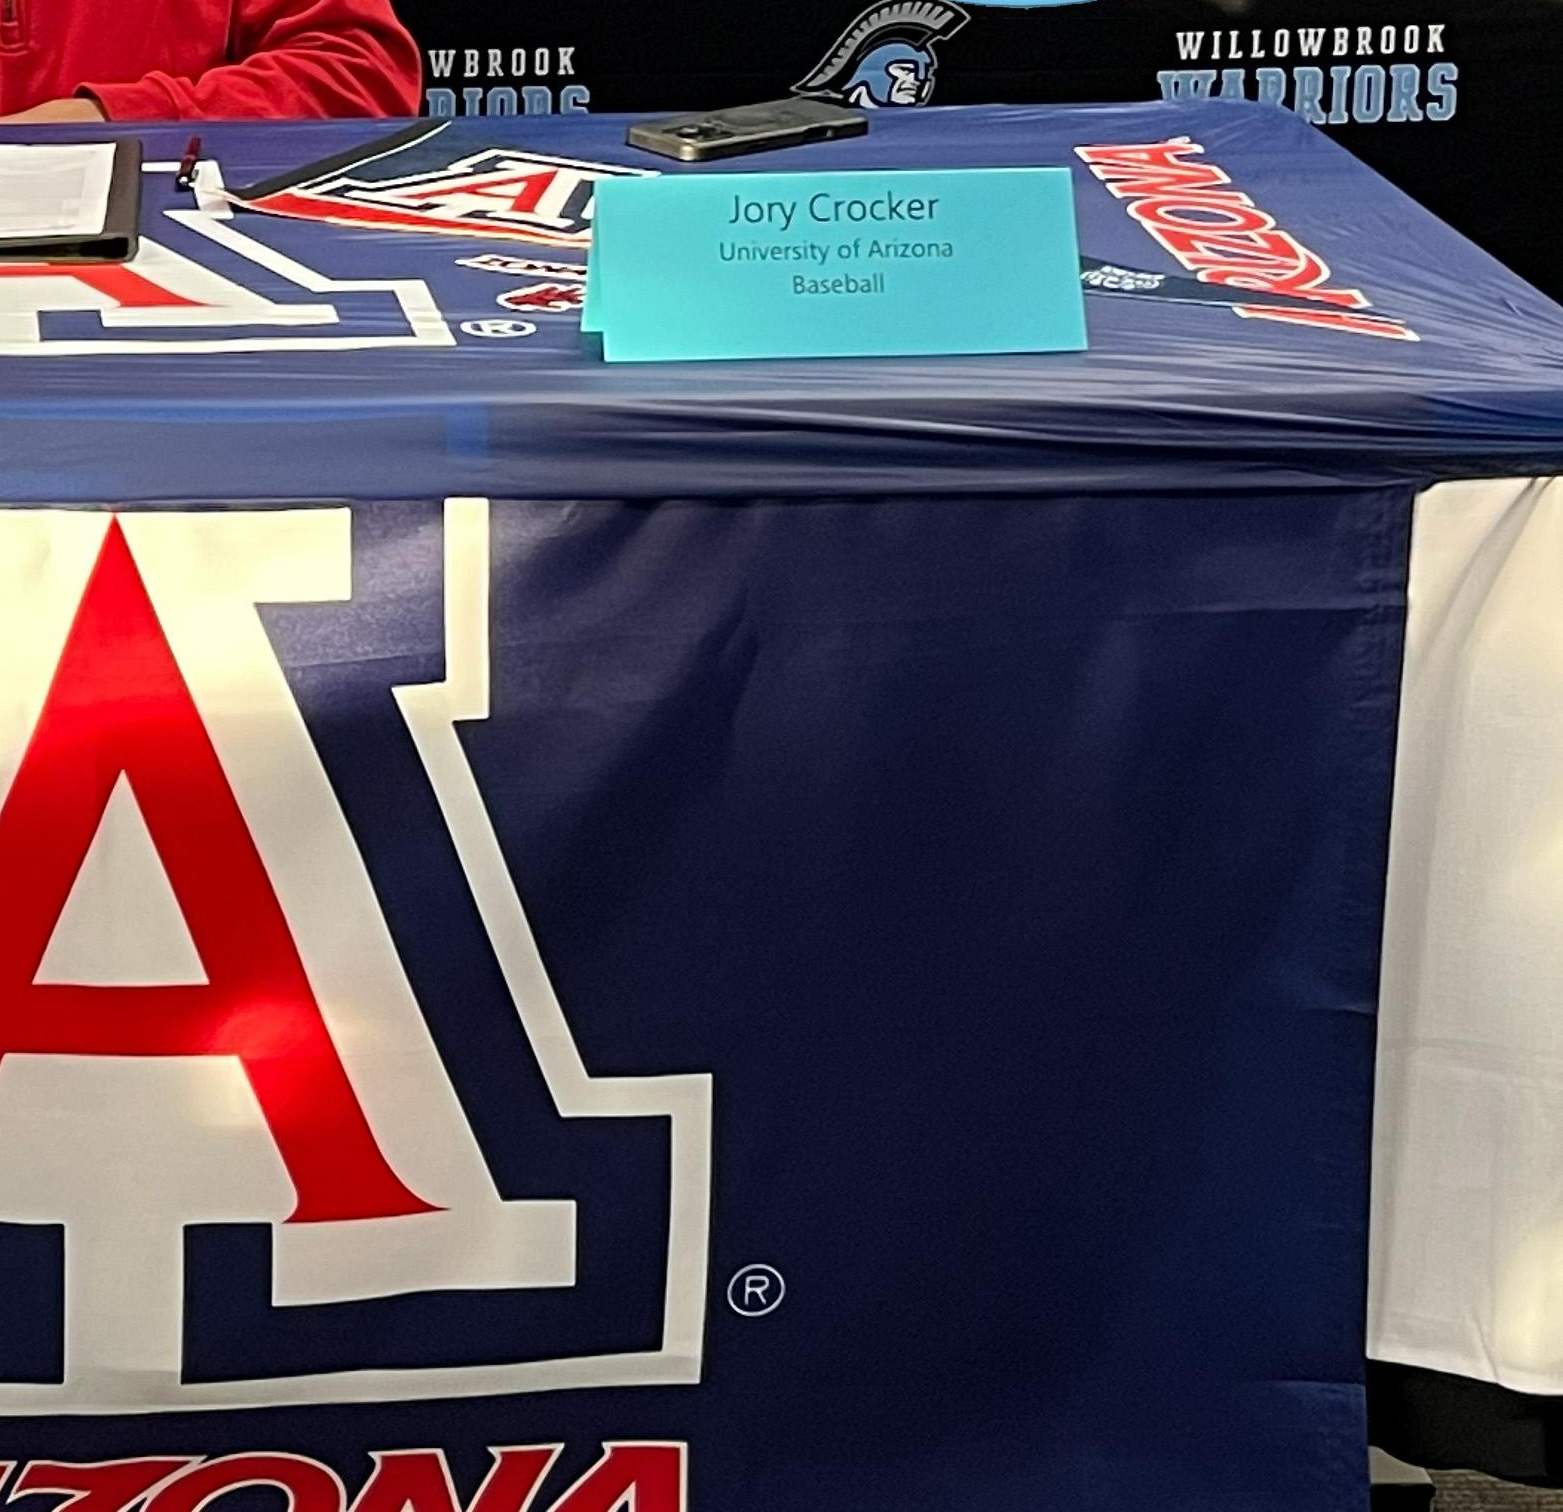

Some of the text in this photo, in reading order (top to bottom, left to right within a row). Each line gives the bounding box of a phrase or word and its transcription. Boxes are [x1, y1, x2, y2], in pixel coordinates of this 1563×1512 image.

[1176, 24, 1445, 60] WILLOWBROOK
[428, 46, 575, 78] WBROOK
[728, 189, 941, 233] Jory Crocker
[719, 238, 954, 267] University of Arizona
[792, 272, 886, 296] Baseball
